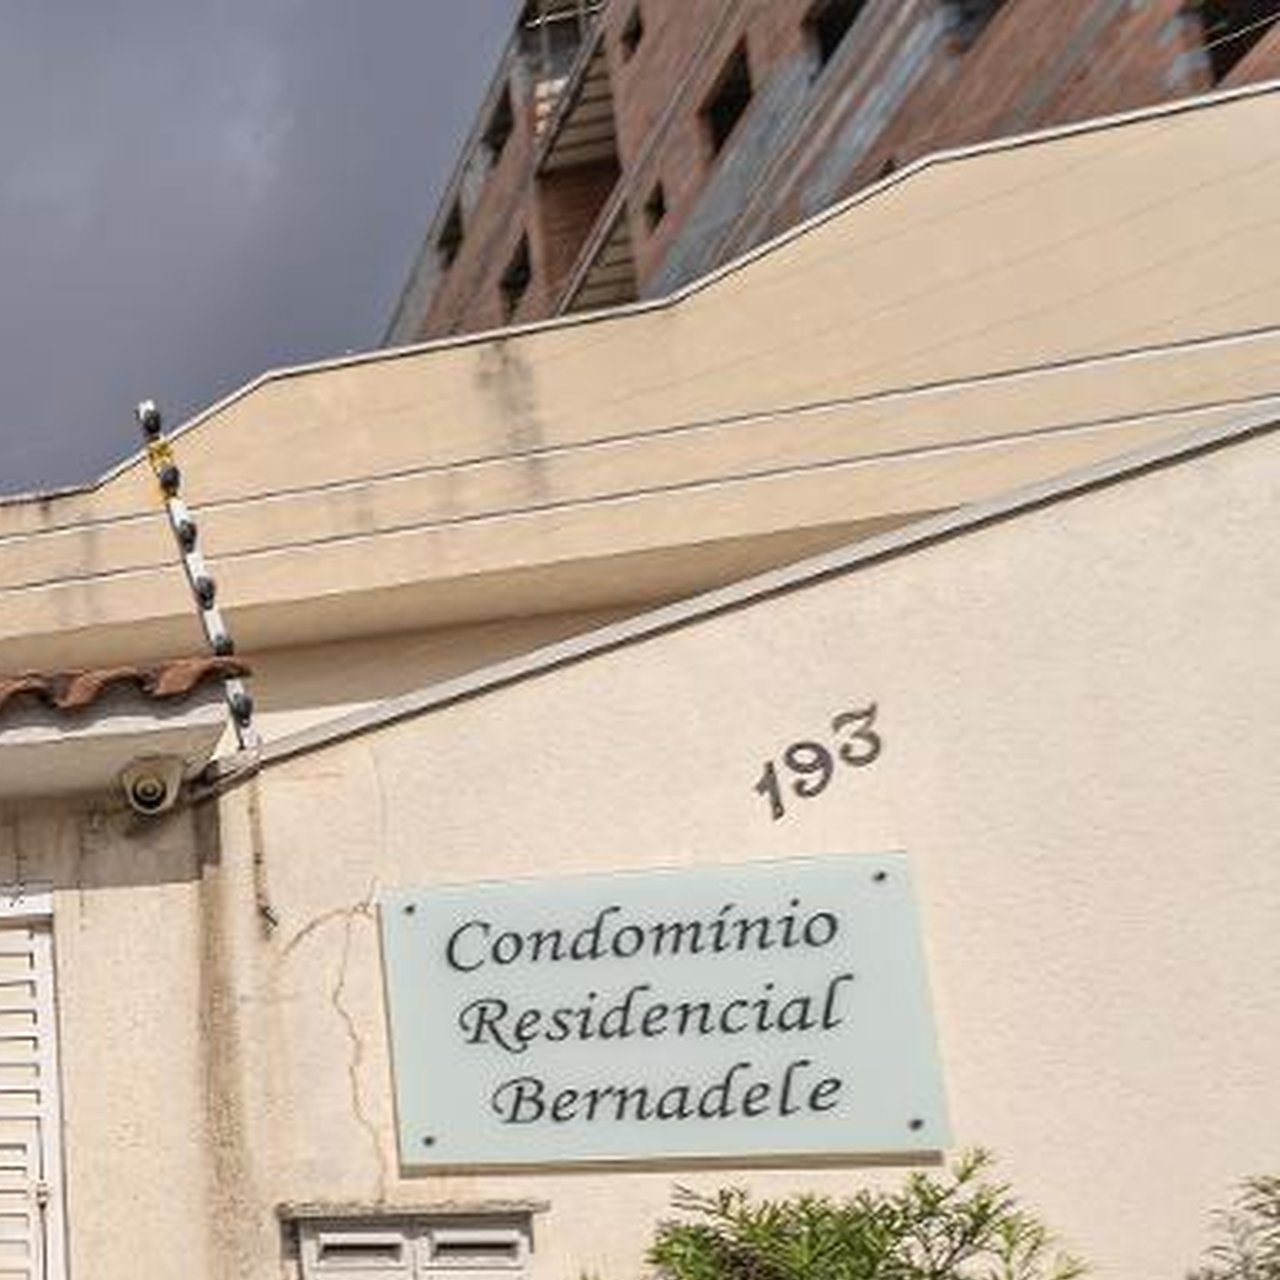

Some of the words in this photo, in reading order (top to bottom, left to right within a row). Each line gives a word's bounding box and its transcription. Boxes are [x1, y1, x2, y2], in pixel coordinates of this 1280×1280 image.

[755, 703, 882, 821] 193
[445, 898, 839, 973] Condomínio
[458, 973, 854, 1054] Residencial
[492, 1059, 843, 1124] Bernadele
